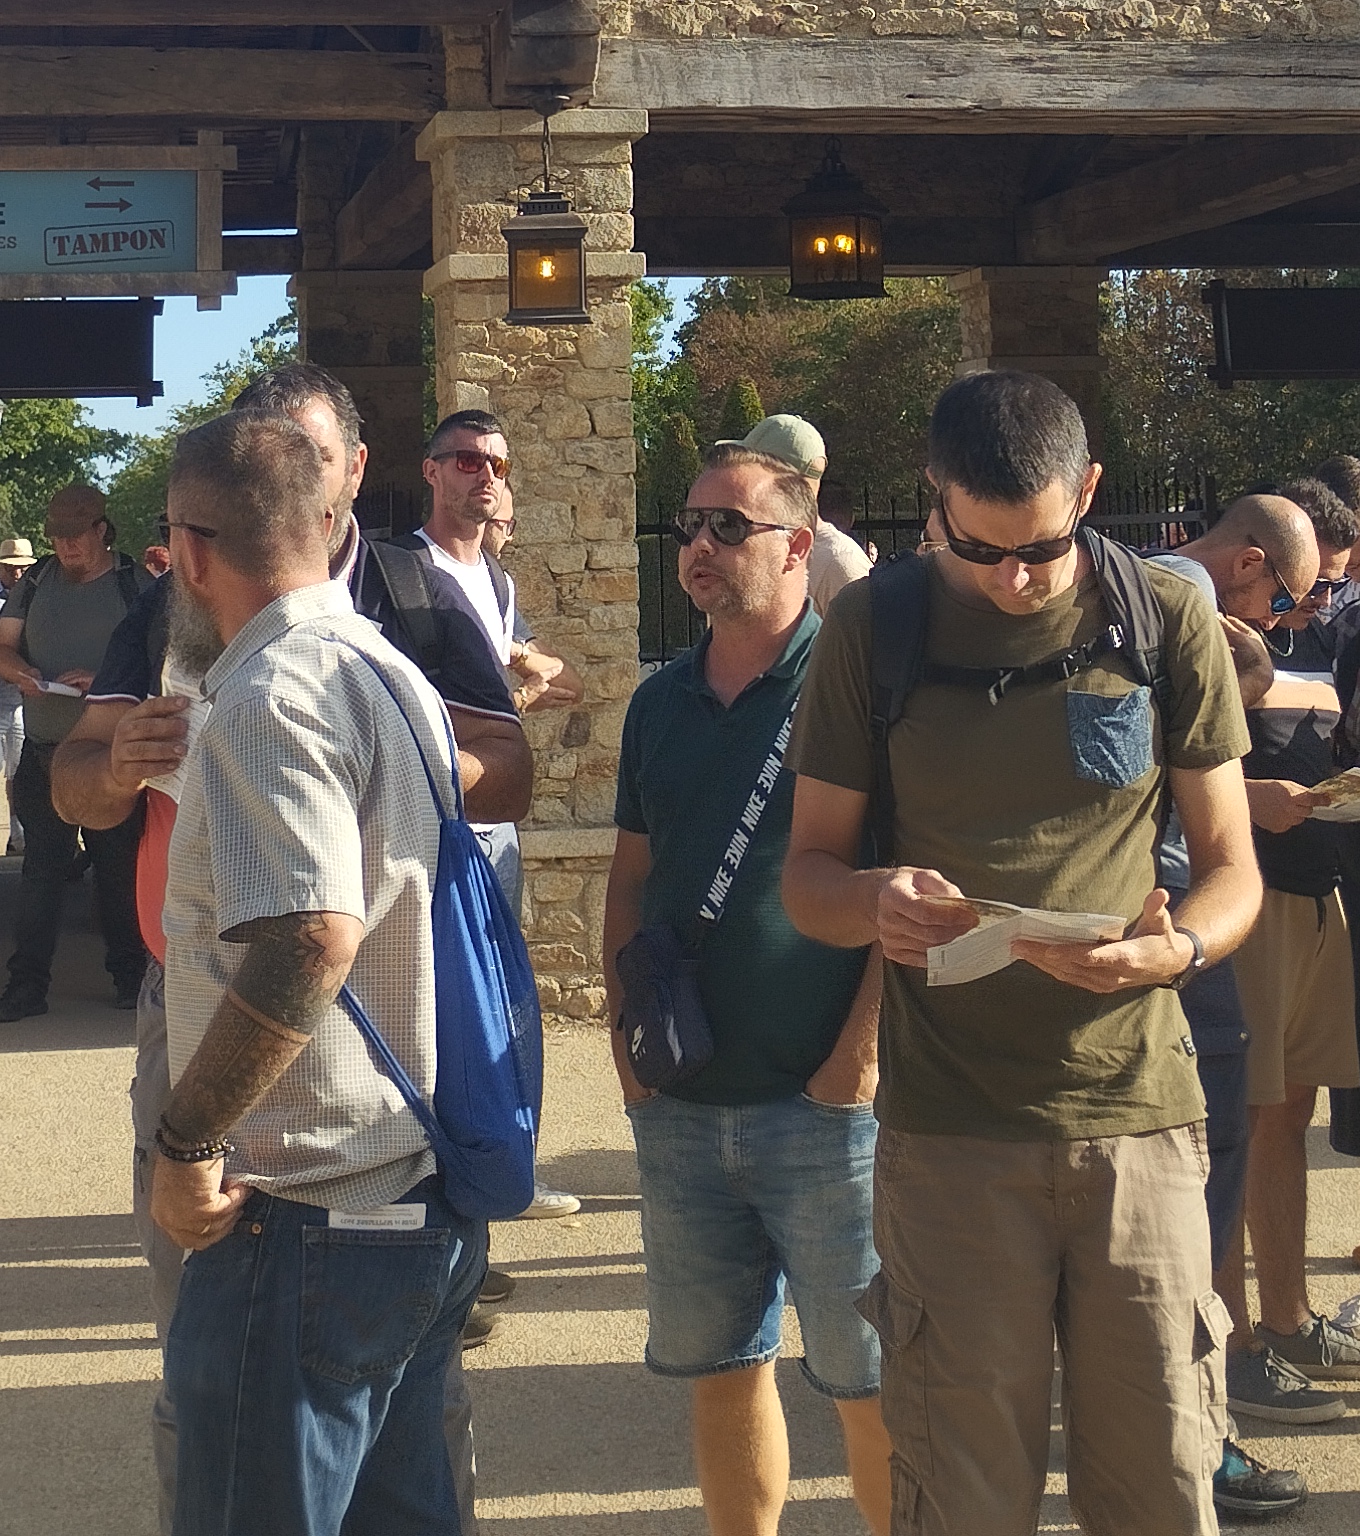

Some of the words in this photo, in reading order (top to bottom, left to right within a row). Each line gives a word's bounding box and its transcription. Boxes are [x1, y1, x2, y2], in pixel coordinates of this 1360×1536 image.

[52, 227, 168, 258] TAMPON
[757, 752, 784, 794] NIKE
[741, 789, 767, 833] NIKE
[724, 827, 750, 870] NIKE
[707, 865, 733, 908] NIKE
